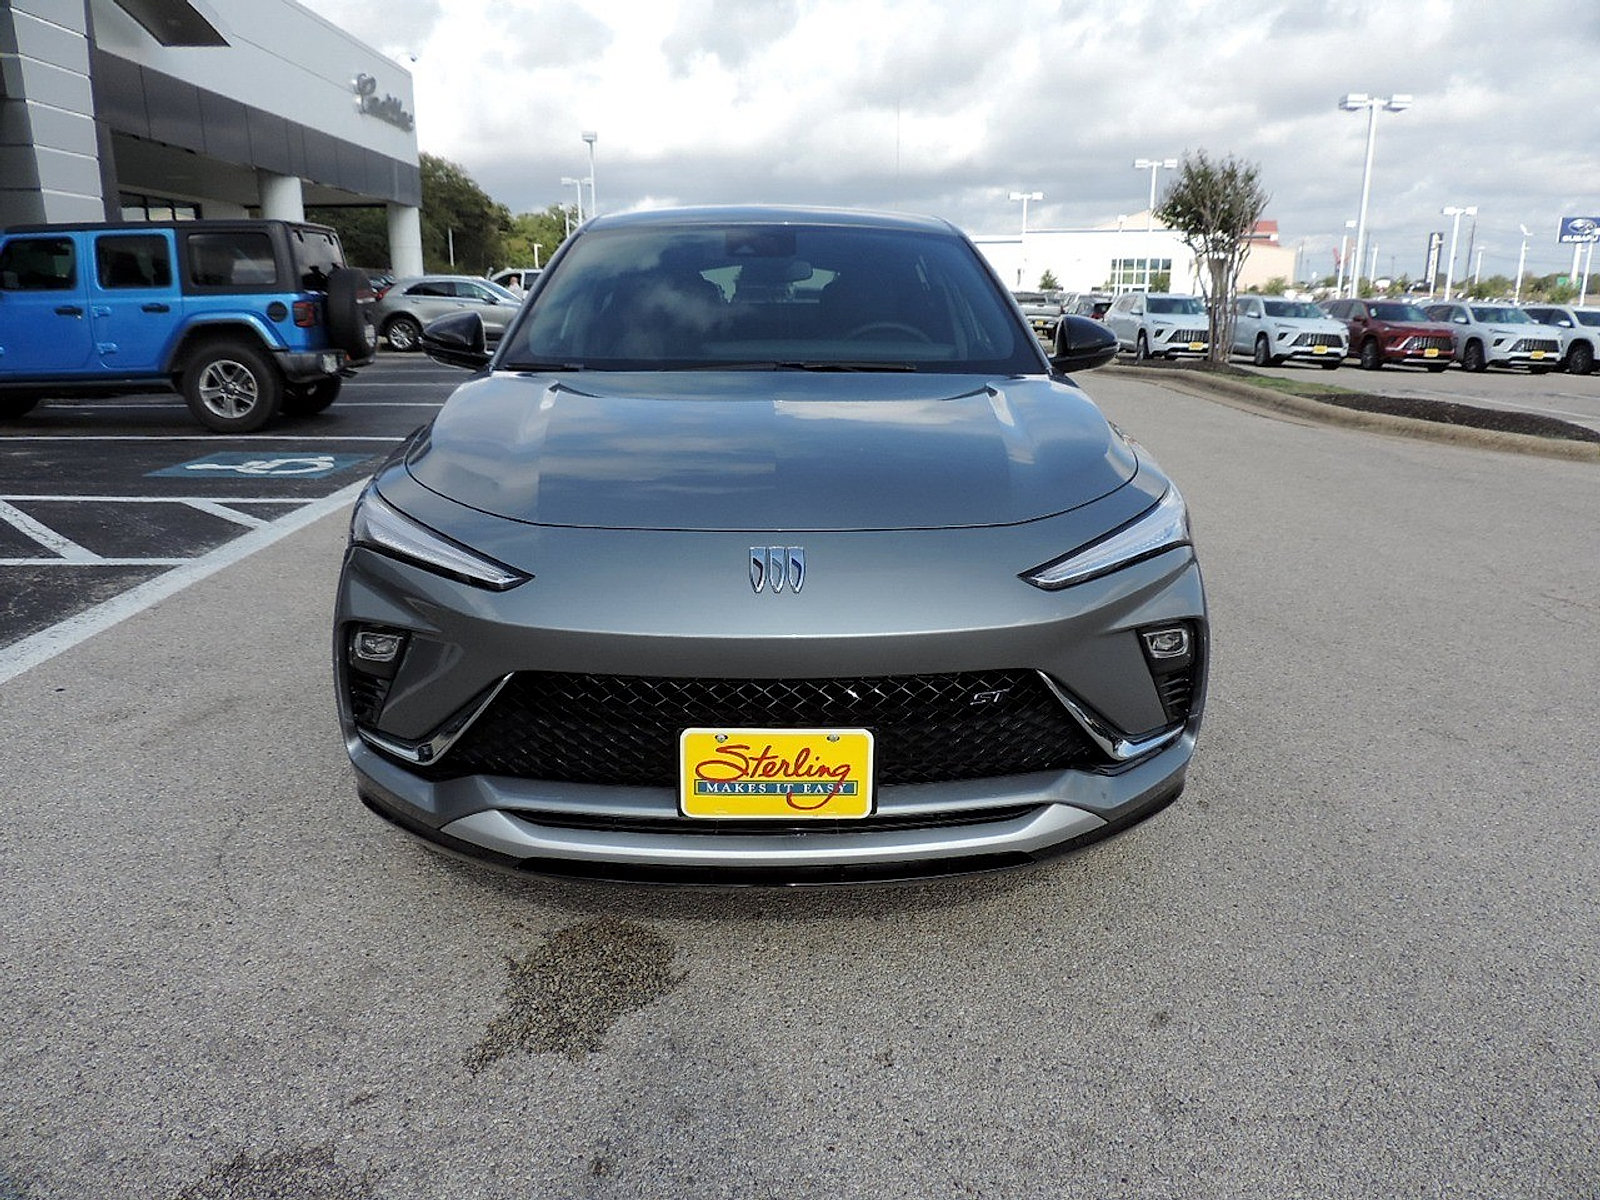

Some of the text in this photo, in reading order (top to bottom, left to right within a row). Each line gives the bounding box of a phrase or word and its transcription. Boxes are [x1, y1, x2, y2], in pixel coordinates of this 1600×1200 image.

[969, 687, 1011, 706] ST
[695, 744, 851, 810] Sterling
[705, 782, 848, 793] MAKES IT EASY
